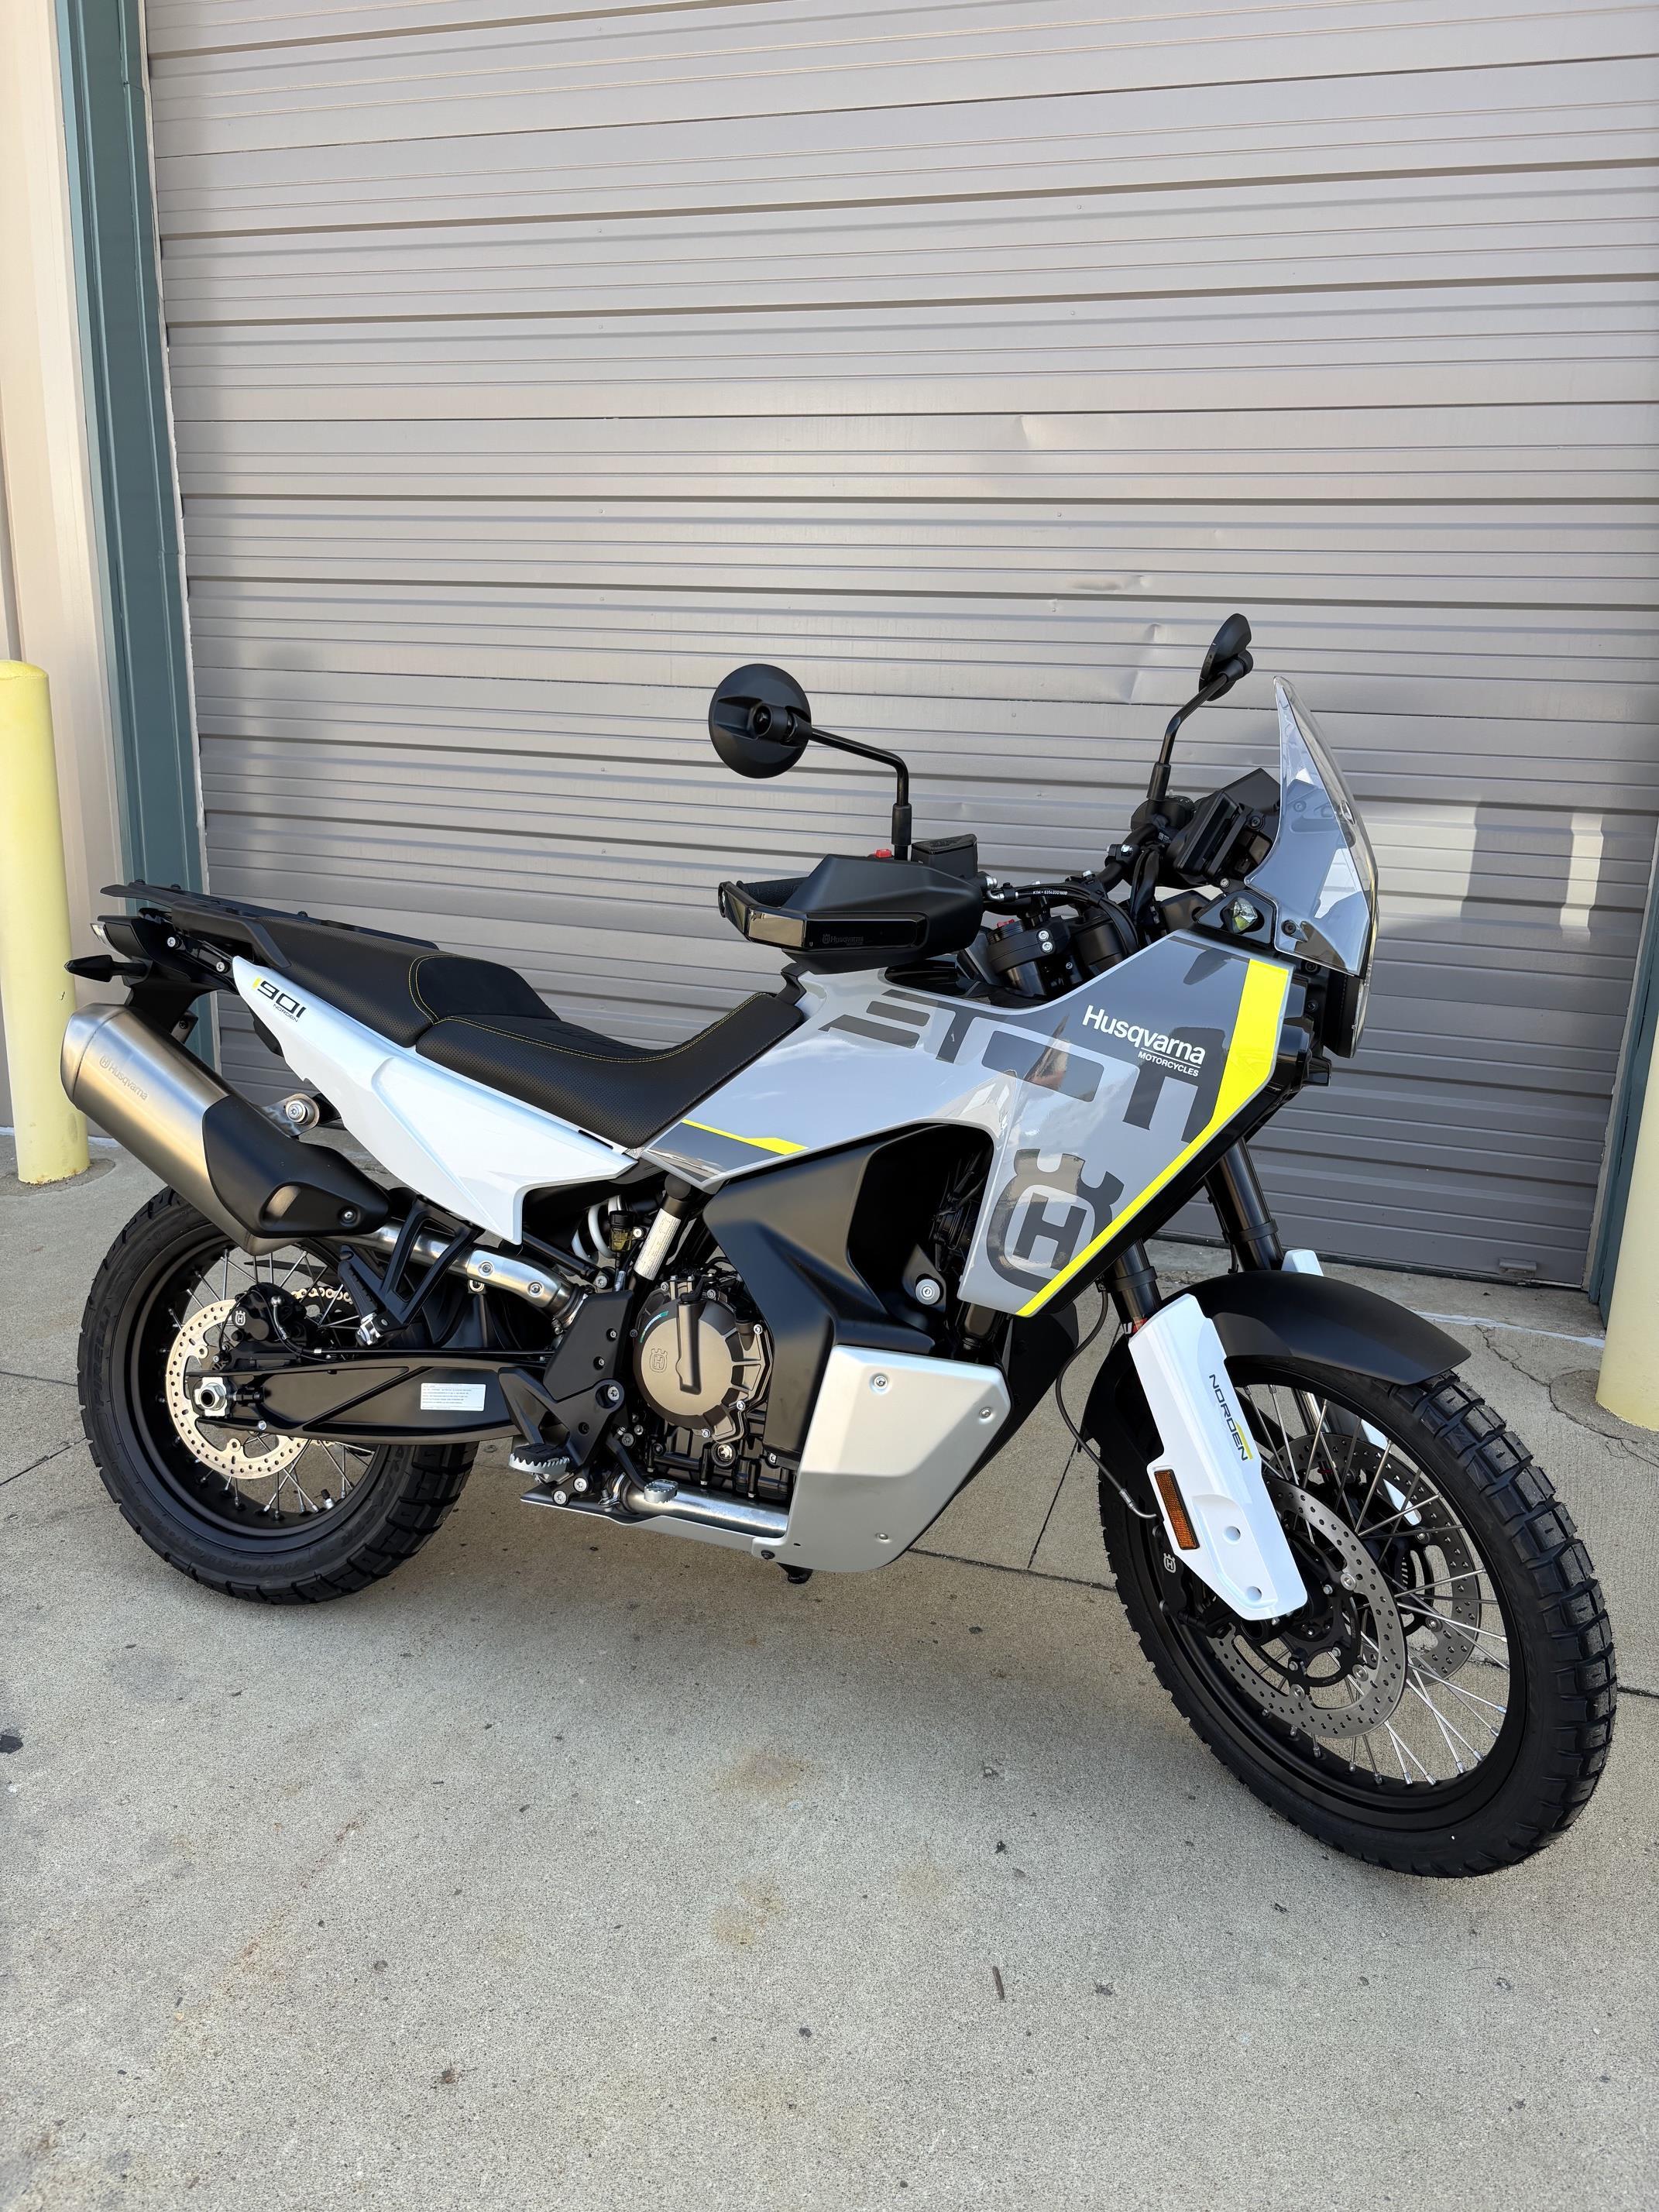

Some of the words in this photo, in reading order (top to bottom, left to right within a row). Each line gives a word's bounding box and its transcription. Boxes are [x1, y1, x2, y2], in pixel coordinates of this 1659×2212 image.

[257, 981, 307, 1018] 901
[273, 1004, 299, 1022] NORDEN
[1082, 1005, 1206, 1065] Husqvarna
[108, 1063, 148, 1101] Husqvarna
[1138, 1050, 1199, 1077] MOTORCYCLES
[1209, 1374, 1249, 1462] NORDEN
